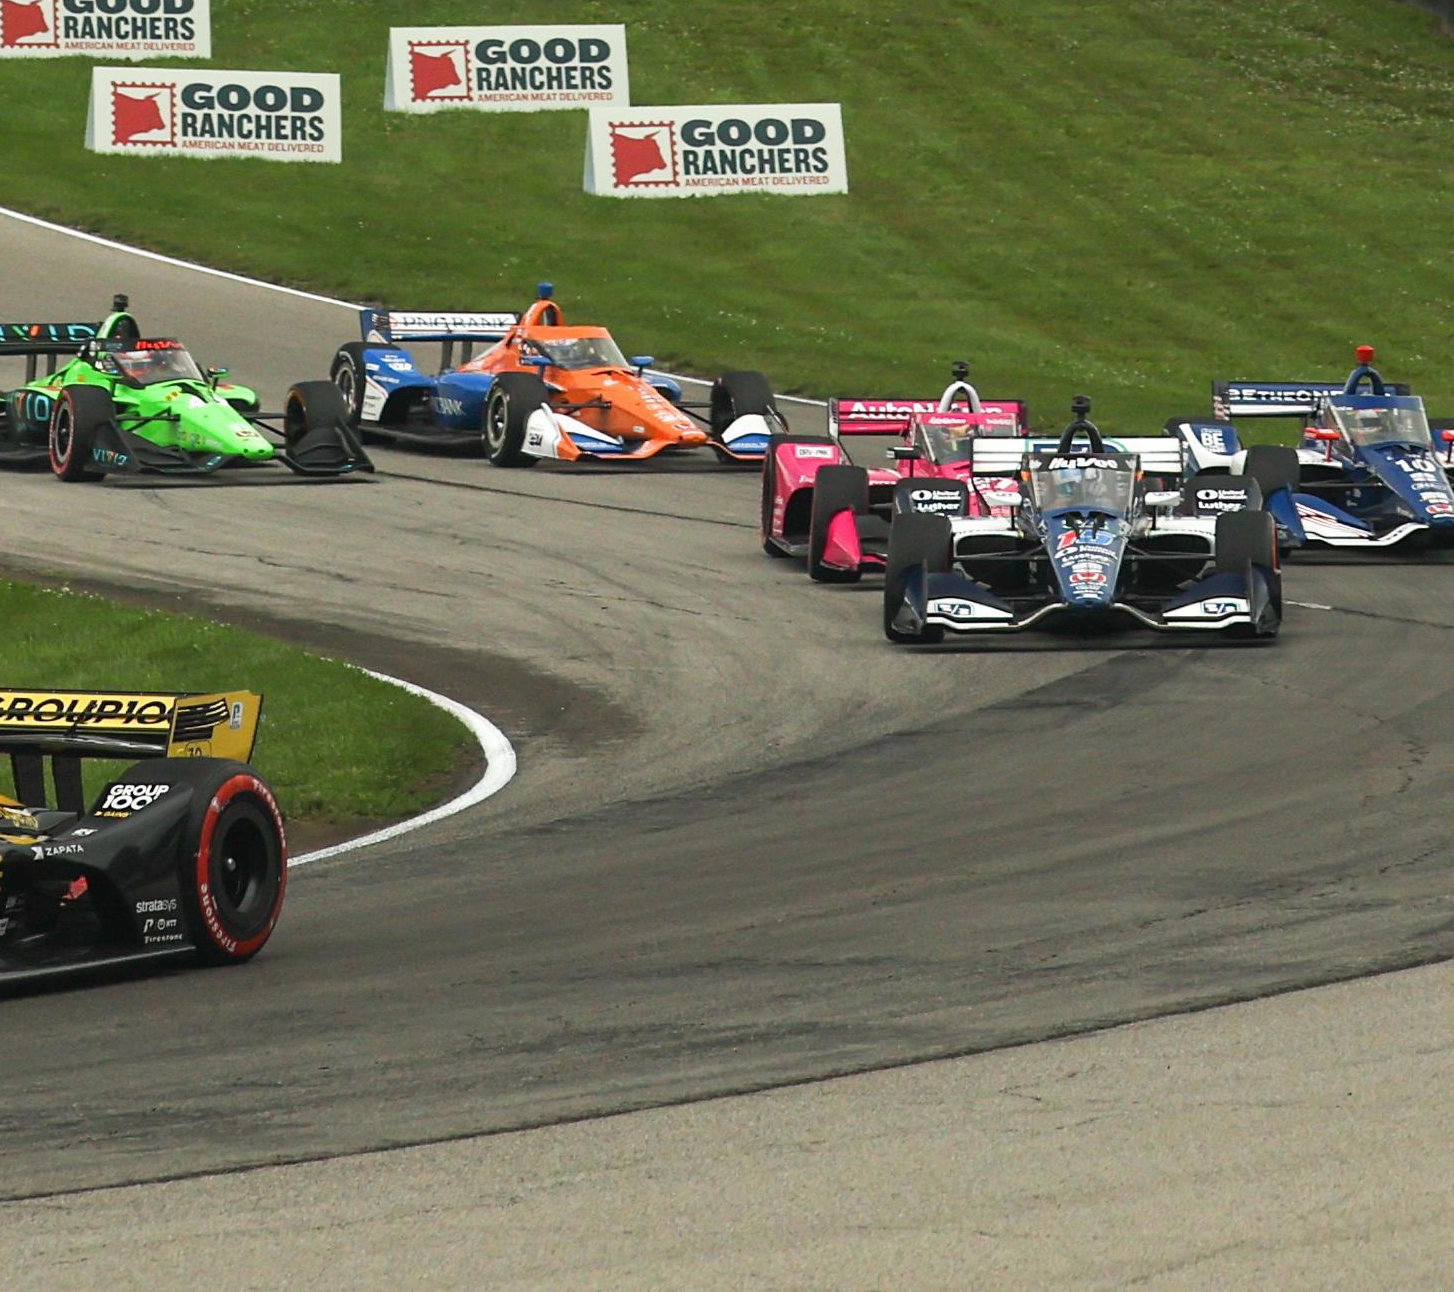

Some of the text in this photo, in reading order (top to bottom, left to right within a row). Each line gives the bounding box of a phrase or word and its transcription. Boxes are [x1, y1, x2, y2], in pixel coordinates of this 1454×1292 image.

[64, 16, 195, 40] RANCHERS
[64, 42, 195, 51] AMERICAN MEAT DELIVERED
[475, 38, 611, 64] GOOD
[476, 65, 612, 91] RANCHERS
[181, 82, 324, 113] GOOD
[478, 92, 612, 102] AMERICAN MEAT DELIVERED
[181, 112, 324, 142] RANCHERS
[680, 119, 826, 147] GOOD
[182, 141, 325, 153] AMERICAN MEAT DELIVERED
[682, 147, 829, 176] RANCHERS
[685, 175, 829, 187] AMERICAN MEAT DELIVERED
[450, 317, 509, 327] BANK
[1201, 432, 1224, 446] BE
[1395, 459, 1436, 472] 10
[915, 503, 960, 512] Luther
[1199, 501, 1241, 511] Luther
[109, 784, 170, 796] GROUP
[45, 844, 84, 857] ZAPATA
[136, 897, 177, 914] stratasys
[200, 883, 237, 953] Firestone
[144, 933, 183, 944] Firestone
